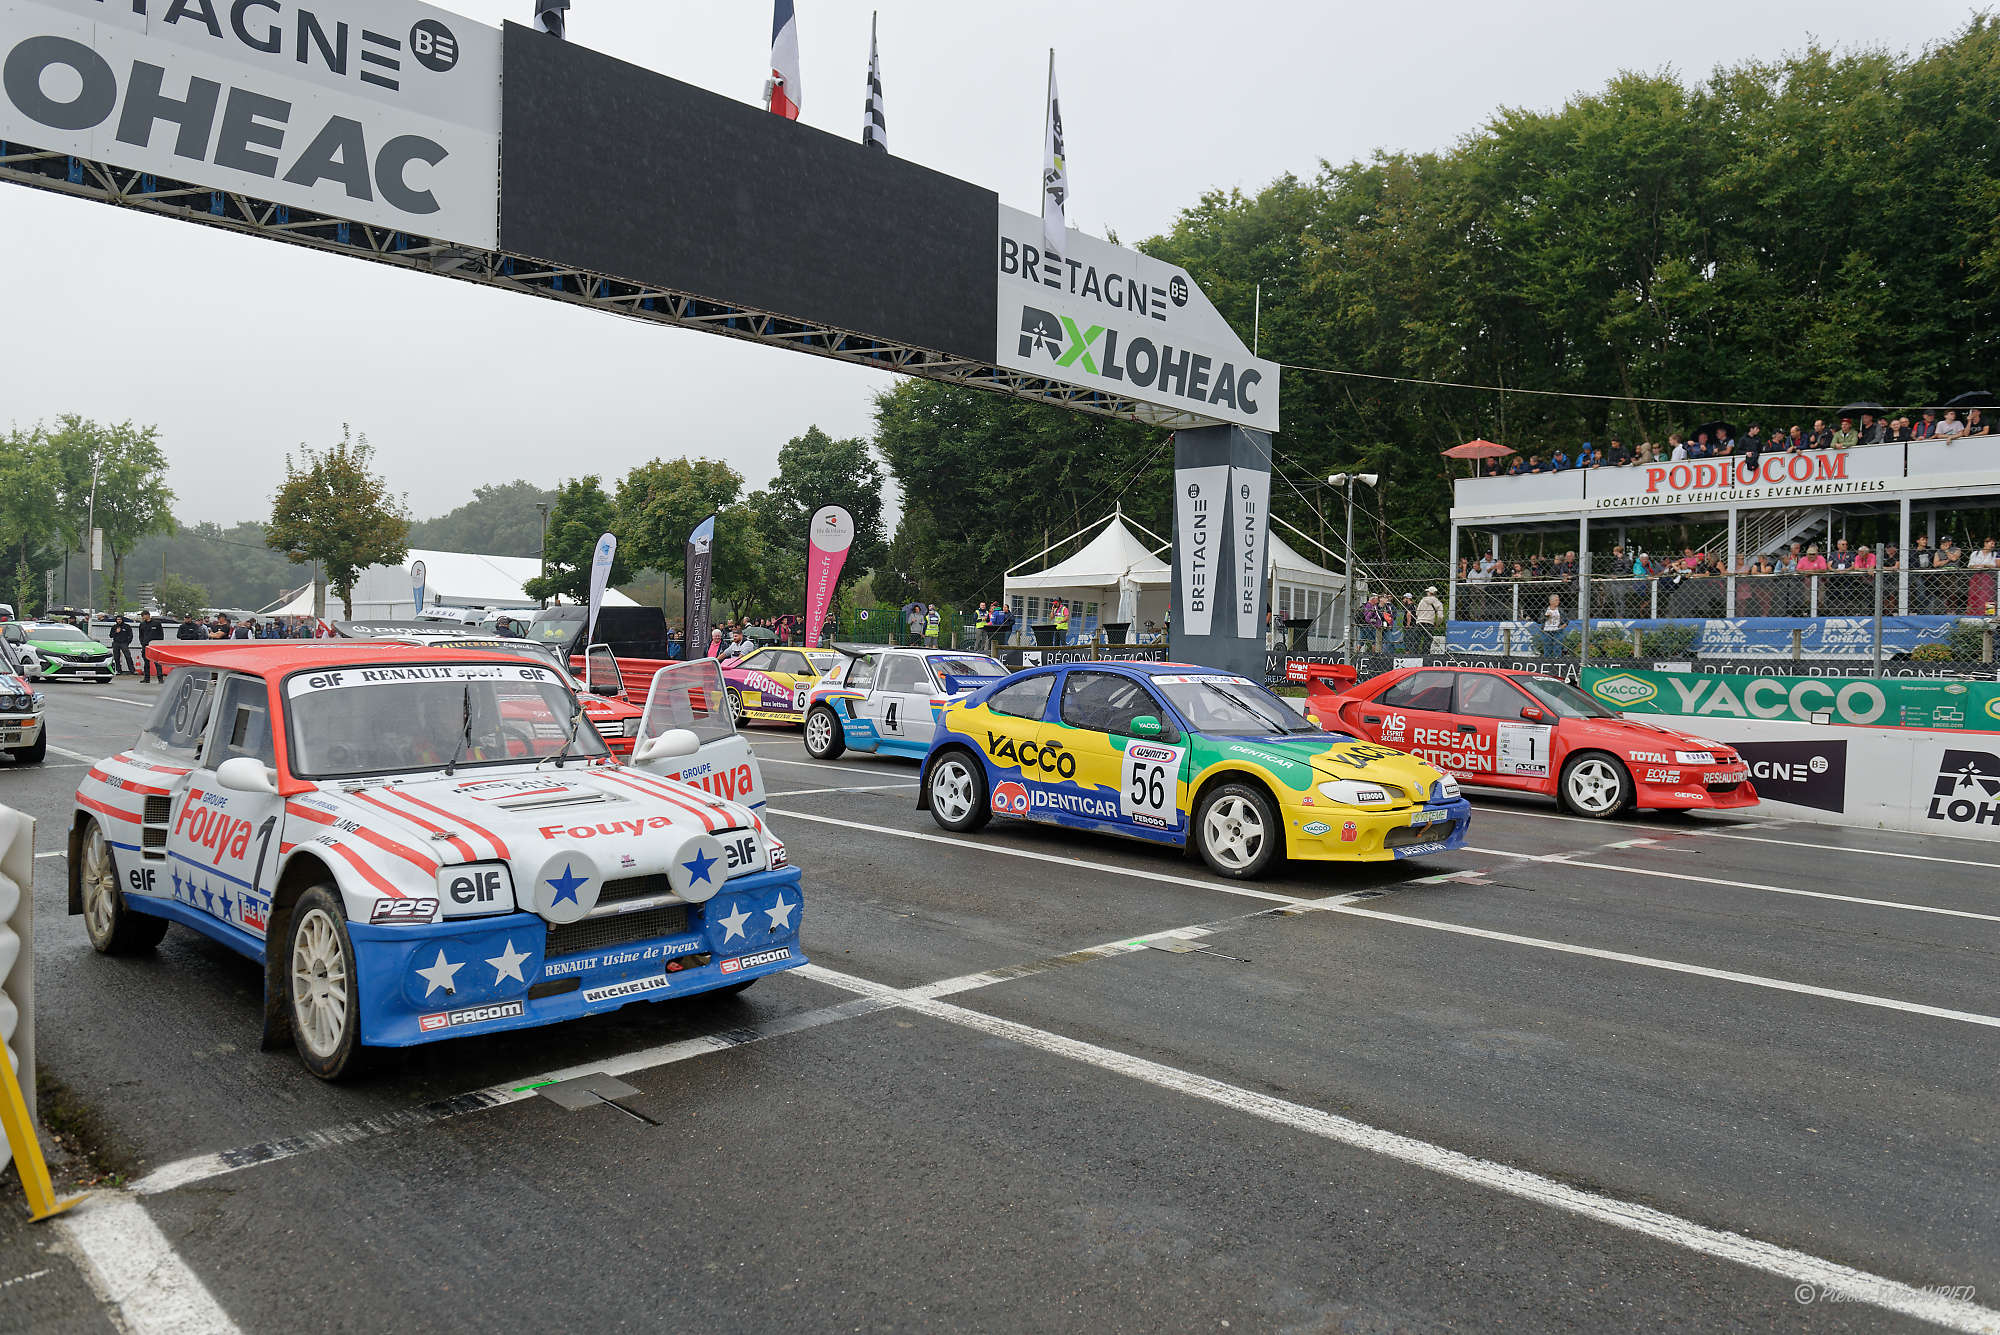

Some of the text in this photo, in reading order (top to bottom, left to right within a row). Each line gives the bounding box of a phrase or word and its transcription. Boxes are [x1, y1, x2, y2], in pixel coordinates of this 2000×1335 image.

[1000, 235, 1167, 322] BRETAGNE
[1646, 452, 1849, 493] PODIOCOM
[1596, 495, 1660, 508] LOCATION
[1666, 494, 1682, 504] DE
[1191, 500, 1207, 612] BRETAGNE
[1243, 502, 1255, 614] BRETAGNE
[808, 556, 831, 643] ille-et-vilaine.fr
[309, 672, 344, 691] elf
[362, 668, 453, 682] RENAULT
[519, 669, 546, 681] elf
[743, 670, 790, 701] VISOREX
[1288, 672, 1307, 680] TOTAL
[797, 691, 806, 708] 6
[1602, 685, 1648, 697] YACCO
[1667, 677, 1887, 725] YACCO
[885, 702, 898, 731] 4
[1139, 722, 1160, 730] YACCO
[987, 731, 1076, 778] YACCO
[1229, 744, 1294, 769] IDENTICAR
[1528, 737, 1535, 761] 1
[1629, 750, 1669, 764] TOTAL
[682, 762, 712, 779] GROUPE
[1661, 775, 1681, 784] TEC
[1130, 762, 1166, 810] 56
[1358, 792, 1384, 801] FERODO
[1674, 791, 1704, 800] GEFCO
[202, 792, 229, 808] GROUPE
[1030, 791, 1118, 818] IDENTICAR
[174, 788, 252, 865] Fouya
[538, 816, 674, 841] Fouya
[1134, 813, 1165, 827] FERODO
[256, 815, 278, 893] 1
[724, 837, 757, 868] elf
[129, 868, 156, 891] elf
[450, 871, 501, 904] elf
[545, 940, 700, 977] RENAULT Usine de Dreux
[742, 949, 789, 968] FACOM
[586, 977, 667, 1001] MICHELIN
[450, 1003, 521, 1025] FACOM
